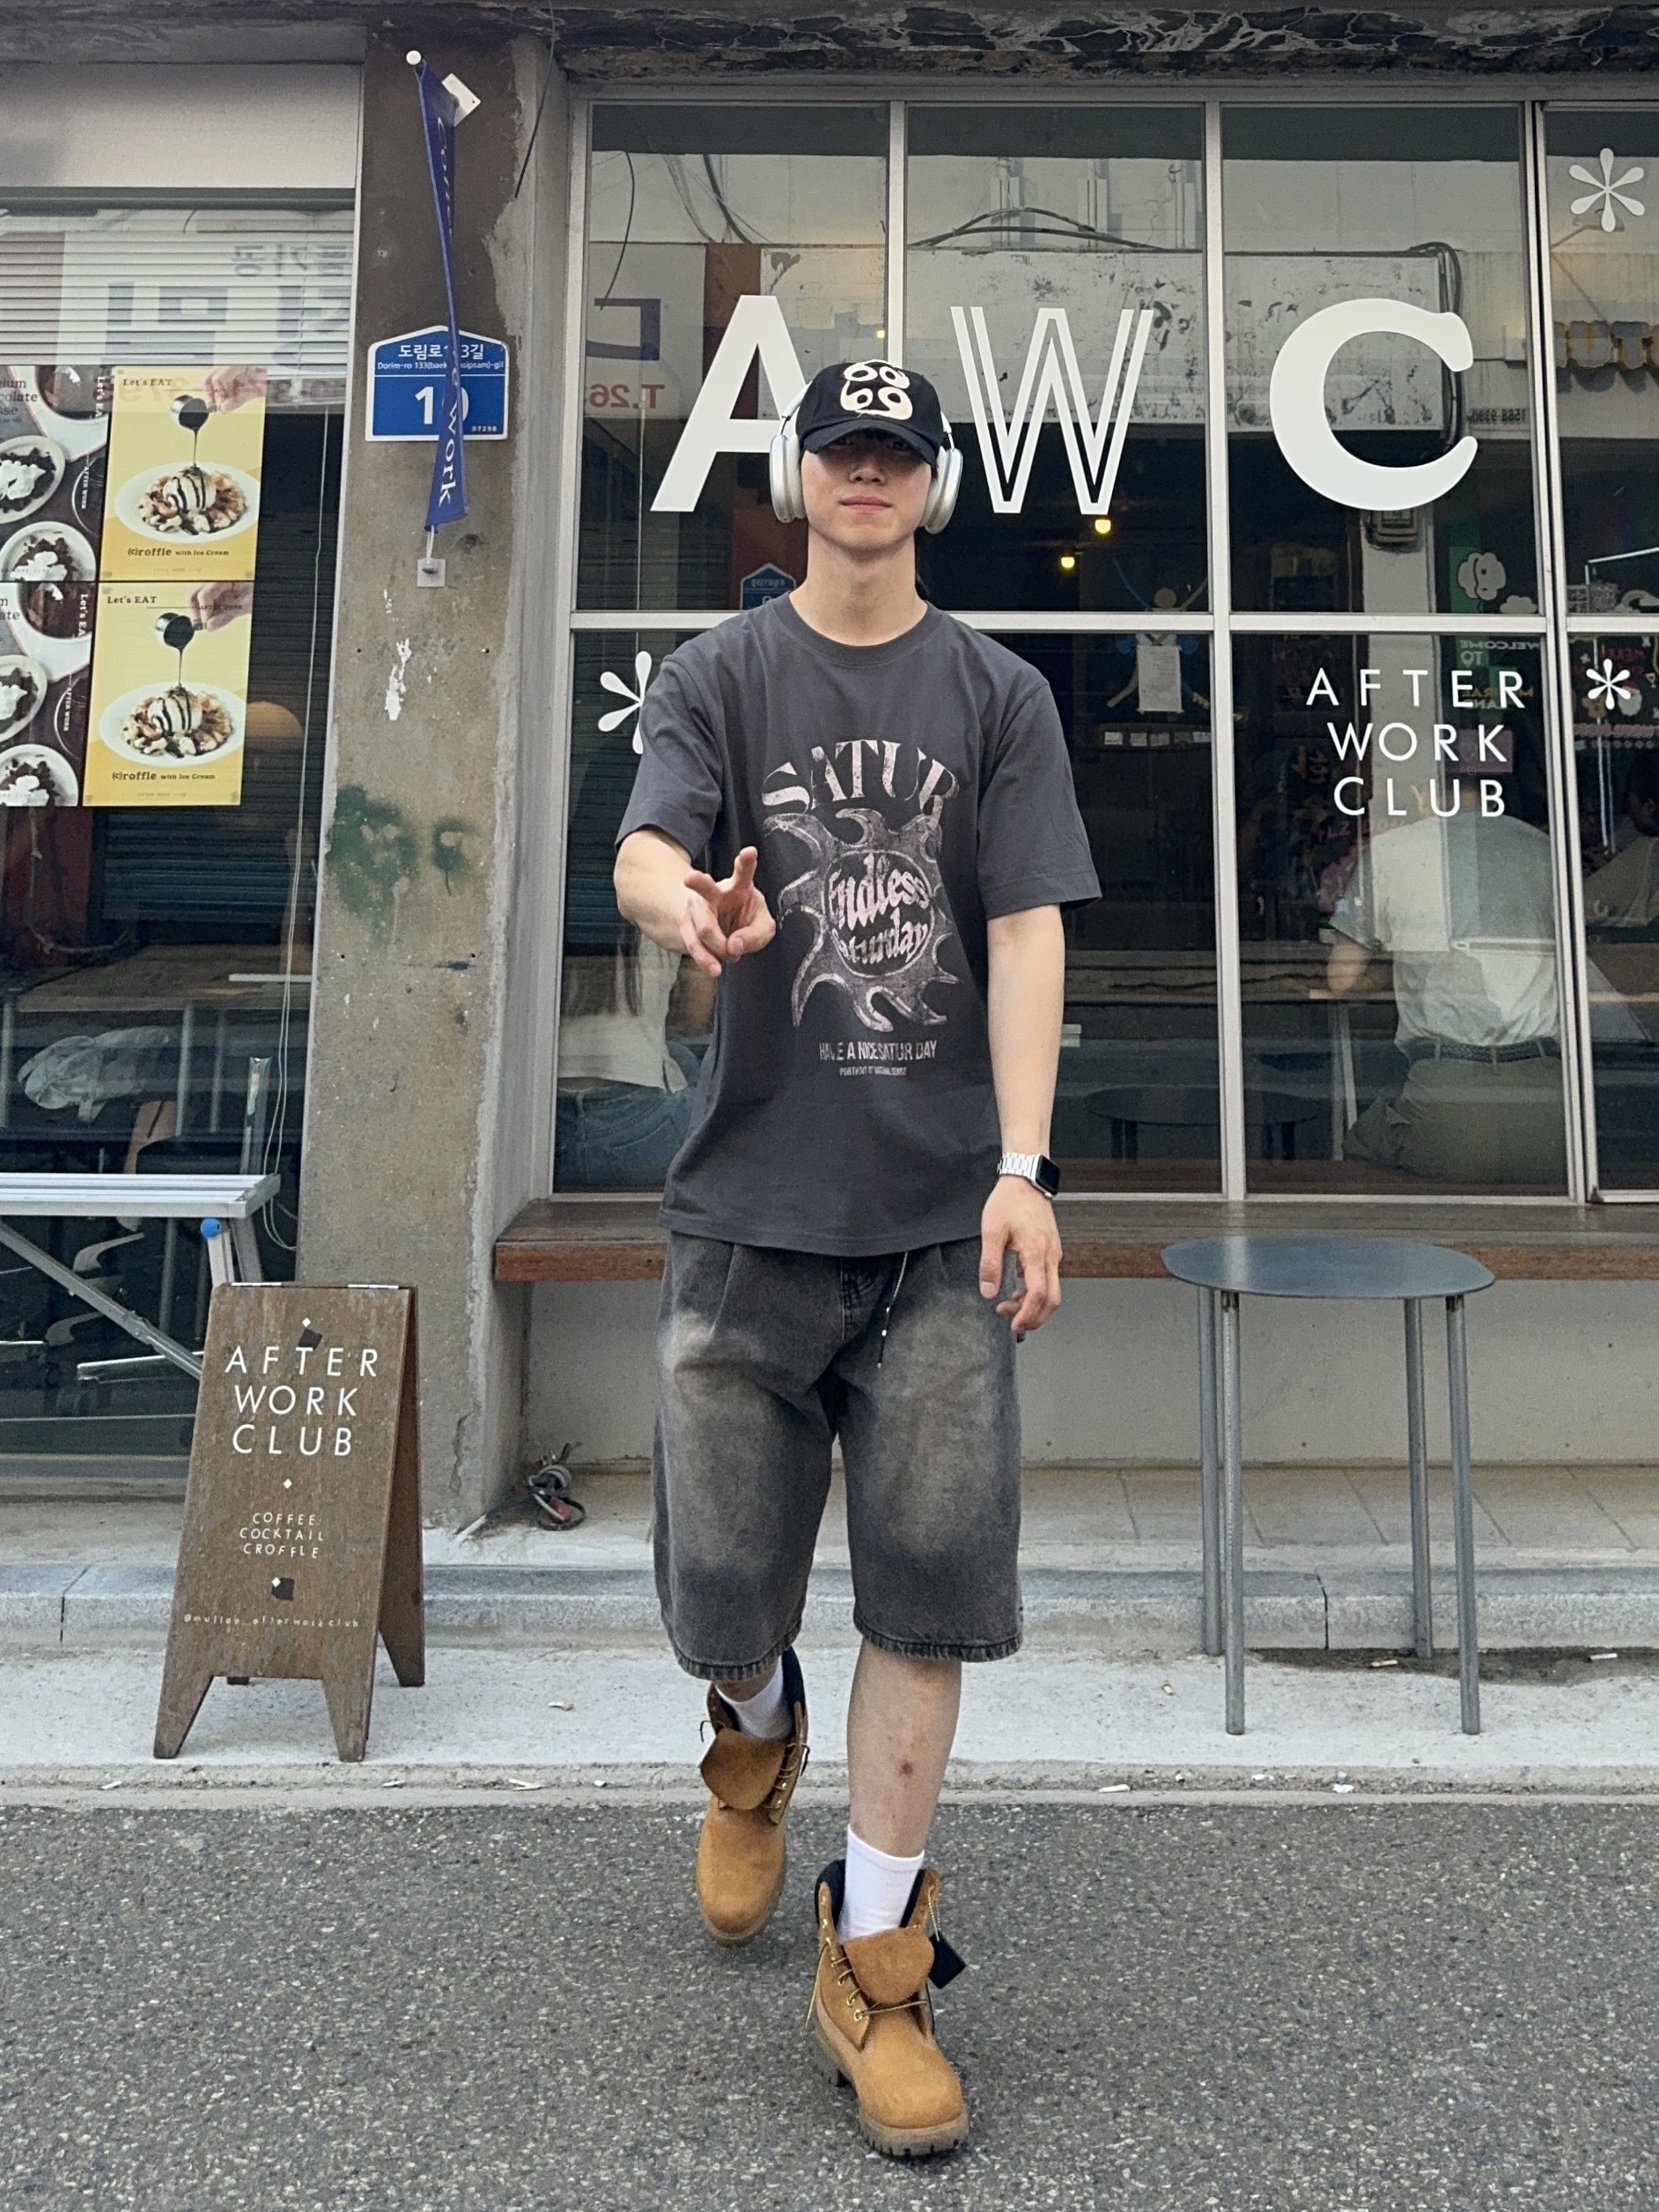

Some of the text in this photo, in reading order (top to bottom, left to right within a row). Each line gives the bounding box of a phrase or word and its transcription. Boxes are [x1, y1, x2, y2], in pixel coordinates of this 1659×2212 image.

[398, 343, 484, 360] 도림로3길
[122, 378, 148, 387] Let's
[128, 548, 173, 557] (c)roffle
[79, 594, 89, 619] Let's
[107, 595, 132, 604] Let's
[1306, 667, 1525, 708] AFTER
[1327, 722, 1508, 763] WORK
[112, 771, 157, 780] (c)roffle
[1333, 776, 1505, 818] CLUB
[819, 1042, 844, 1060] HAVE
[846, 1041, 856, 1060] A
[225, 1345, 378, 1377] AFTER
[234, 1385, 358, 1417] WORK
[232, 1424, 351, 1456] CLUB
[252, 1511, 316, 1526] COFFEE
[240, 1527, 324, 1541] COCKTAIL
[243, 1543, 320, 1559] CROFFLE
